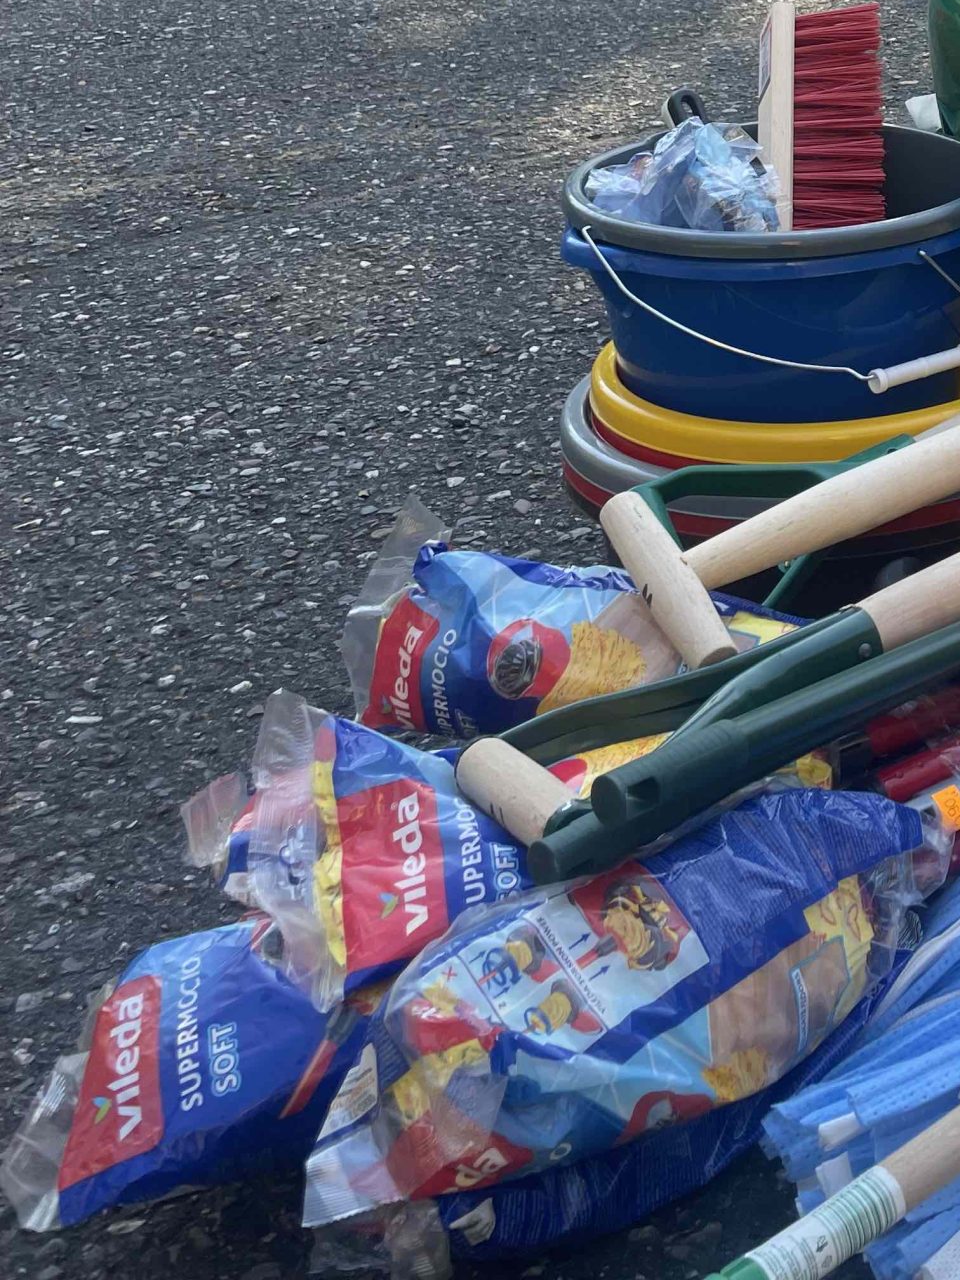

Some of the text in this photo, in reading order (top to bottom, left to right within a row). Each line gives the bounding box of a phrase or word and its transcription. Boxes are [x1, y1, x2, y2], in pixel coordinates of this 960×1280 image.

[390, 625, 424, 731] vileda
[432, 628, 457, 737] UPERMOCIO
[393, 791, 429, 936] vileda
[107, 993, 144, 1141] vileda
[176, 956, 203, 1111] SUPERMOCIO
[212, 1023, 238, 1093] SOFT
